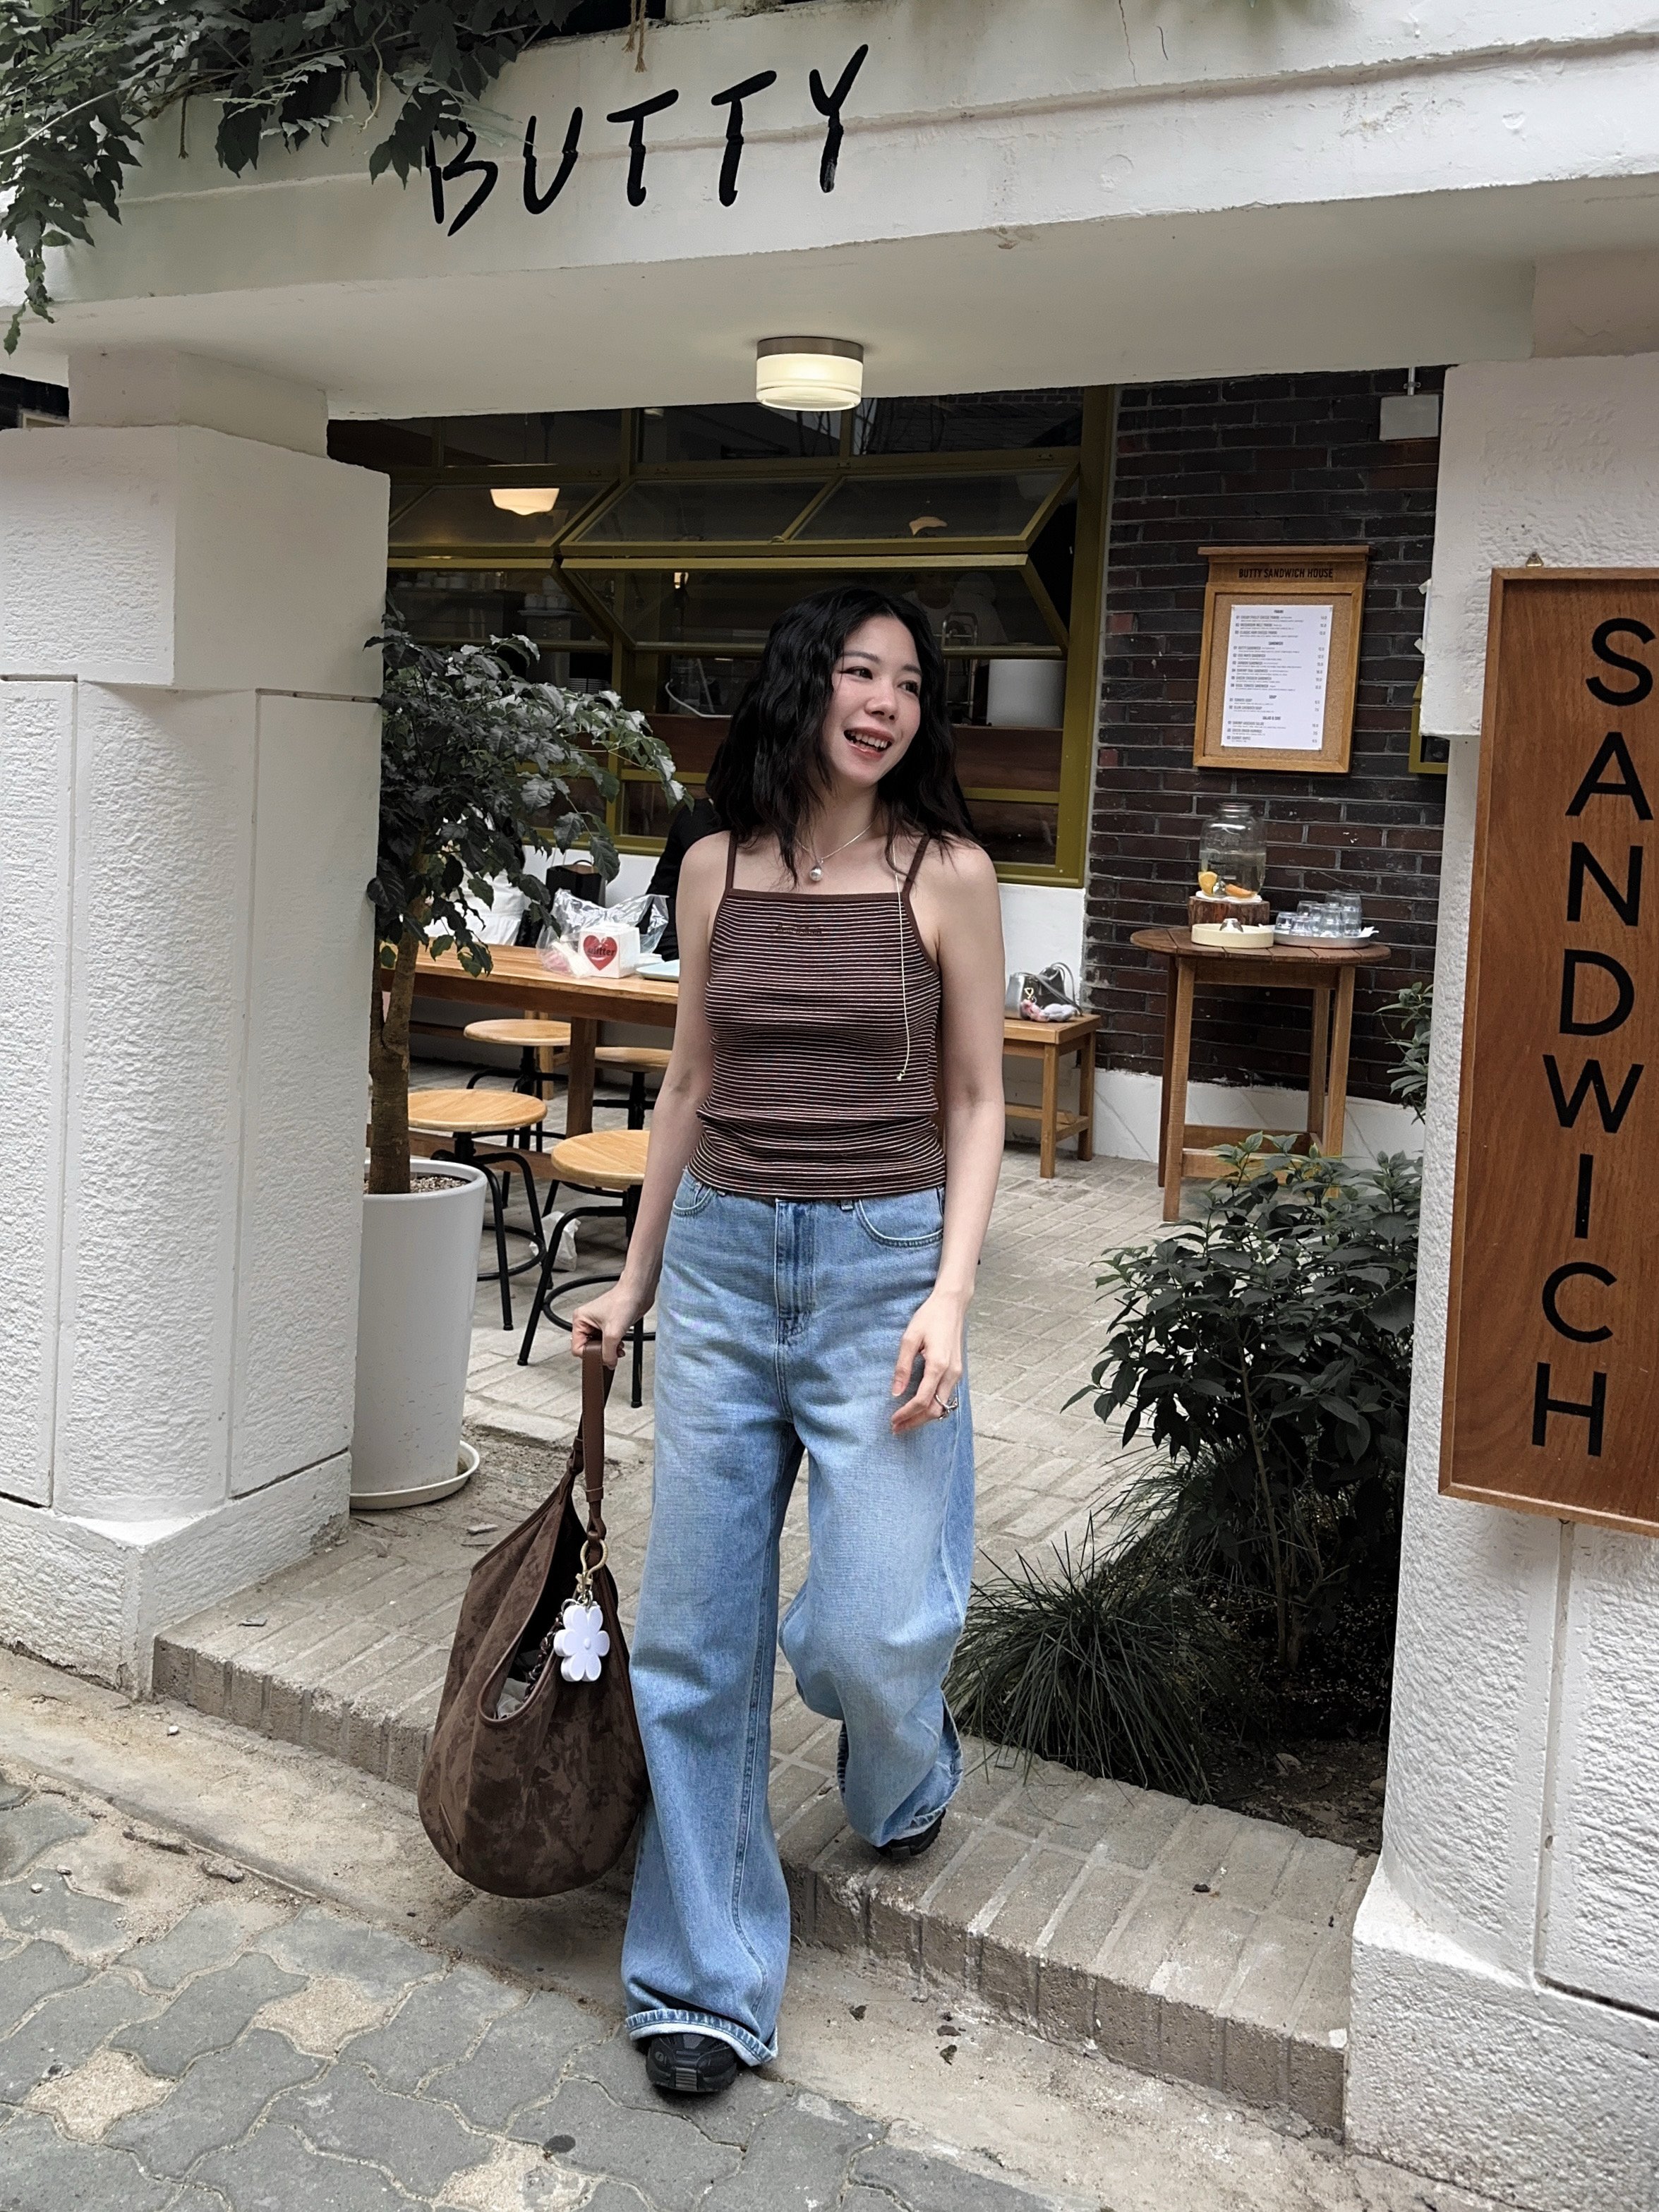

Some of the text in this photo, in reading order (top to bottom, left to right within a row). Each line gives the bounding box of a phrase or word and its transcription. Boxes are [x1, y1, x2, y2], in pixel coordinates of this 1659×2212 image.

[424, 44, 868, 237] BUTTY
[1238, 568, 1334, 578] BUTTY SANDWICH HOUSE
[1532, 617, 1656, 1457] SANDWICH
